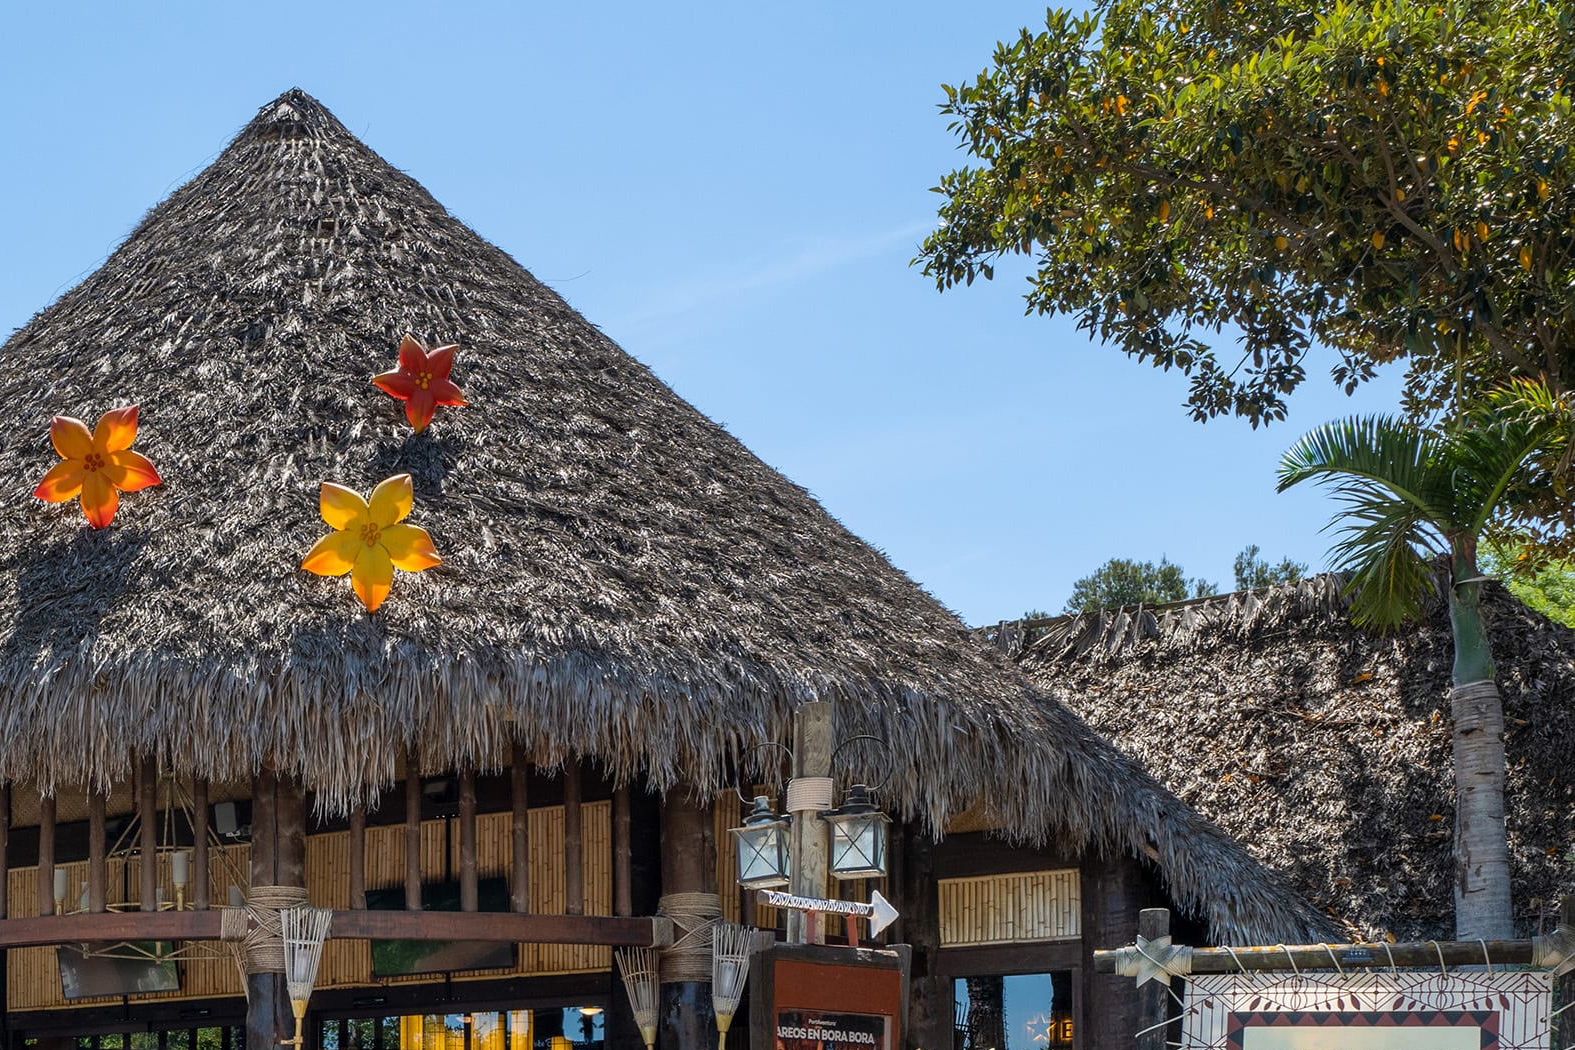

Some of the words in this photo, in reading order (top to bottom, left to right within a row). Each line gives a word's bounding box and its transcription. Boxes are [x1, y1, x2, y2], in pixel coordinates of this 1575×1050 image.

[807, 1028, 821, 1040] EN
[821, 1029, 848, 1042] BORA
[849, 1031, 875, 1044] BORA
